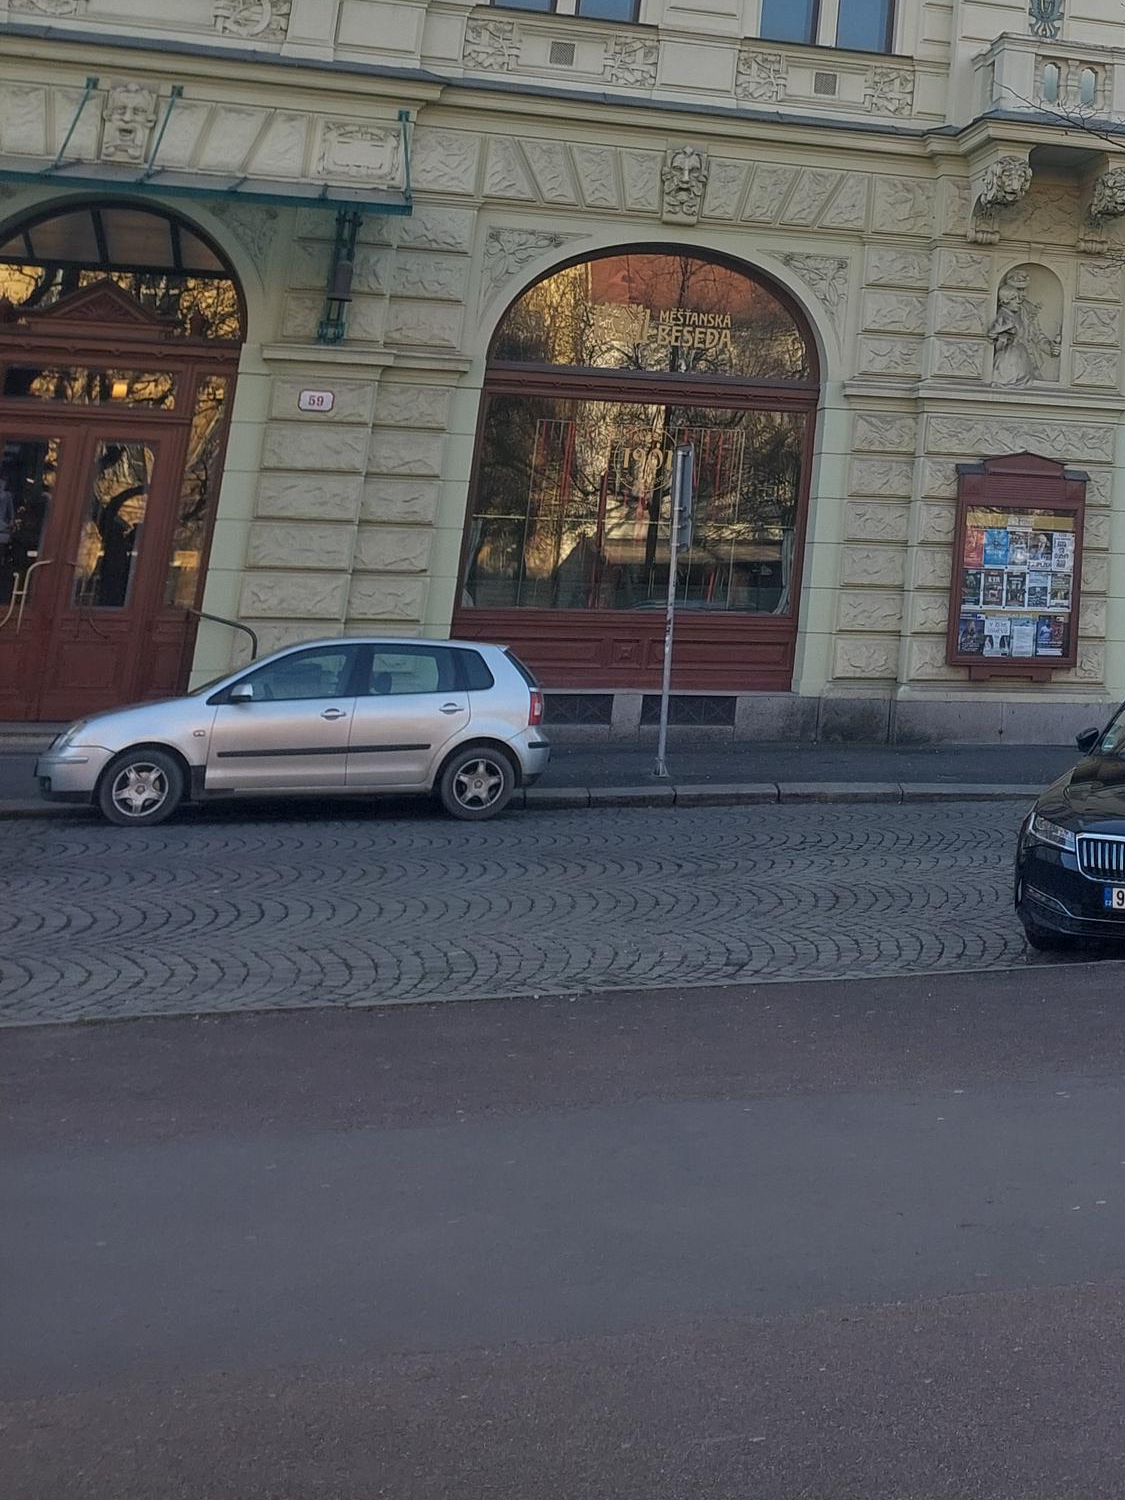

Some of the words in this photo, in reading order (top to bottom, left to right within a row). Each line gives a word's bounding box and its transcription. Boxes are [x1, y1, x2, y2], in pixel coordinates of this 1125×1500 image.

[659, 307, 732, 328] MĚŠŤANSKÁ
[657, 324, 733, 349] BESEDA
[308, 395, 324, 406] 59
[622, 447, 673, 471] 1901
